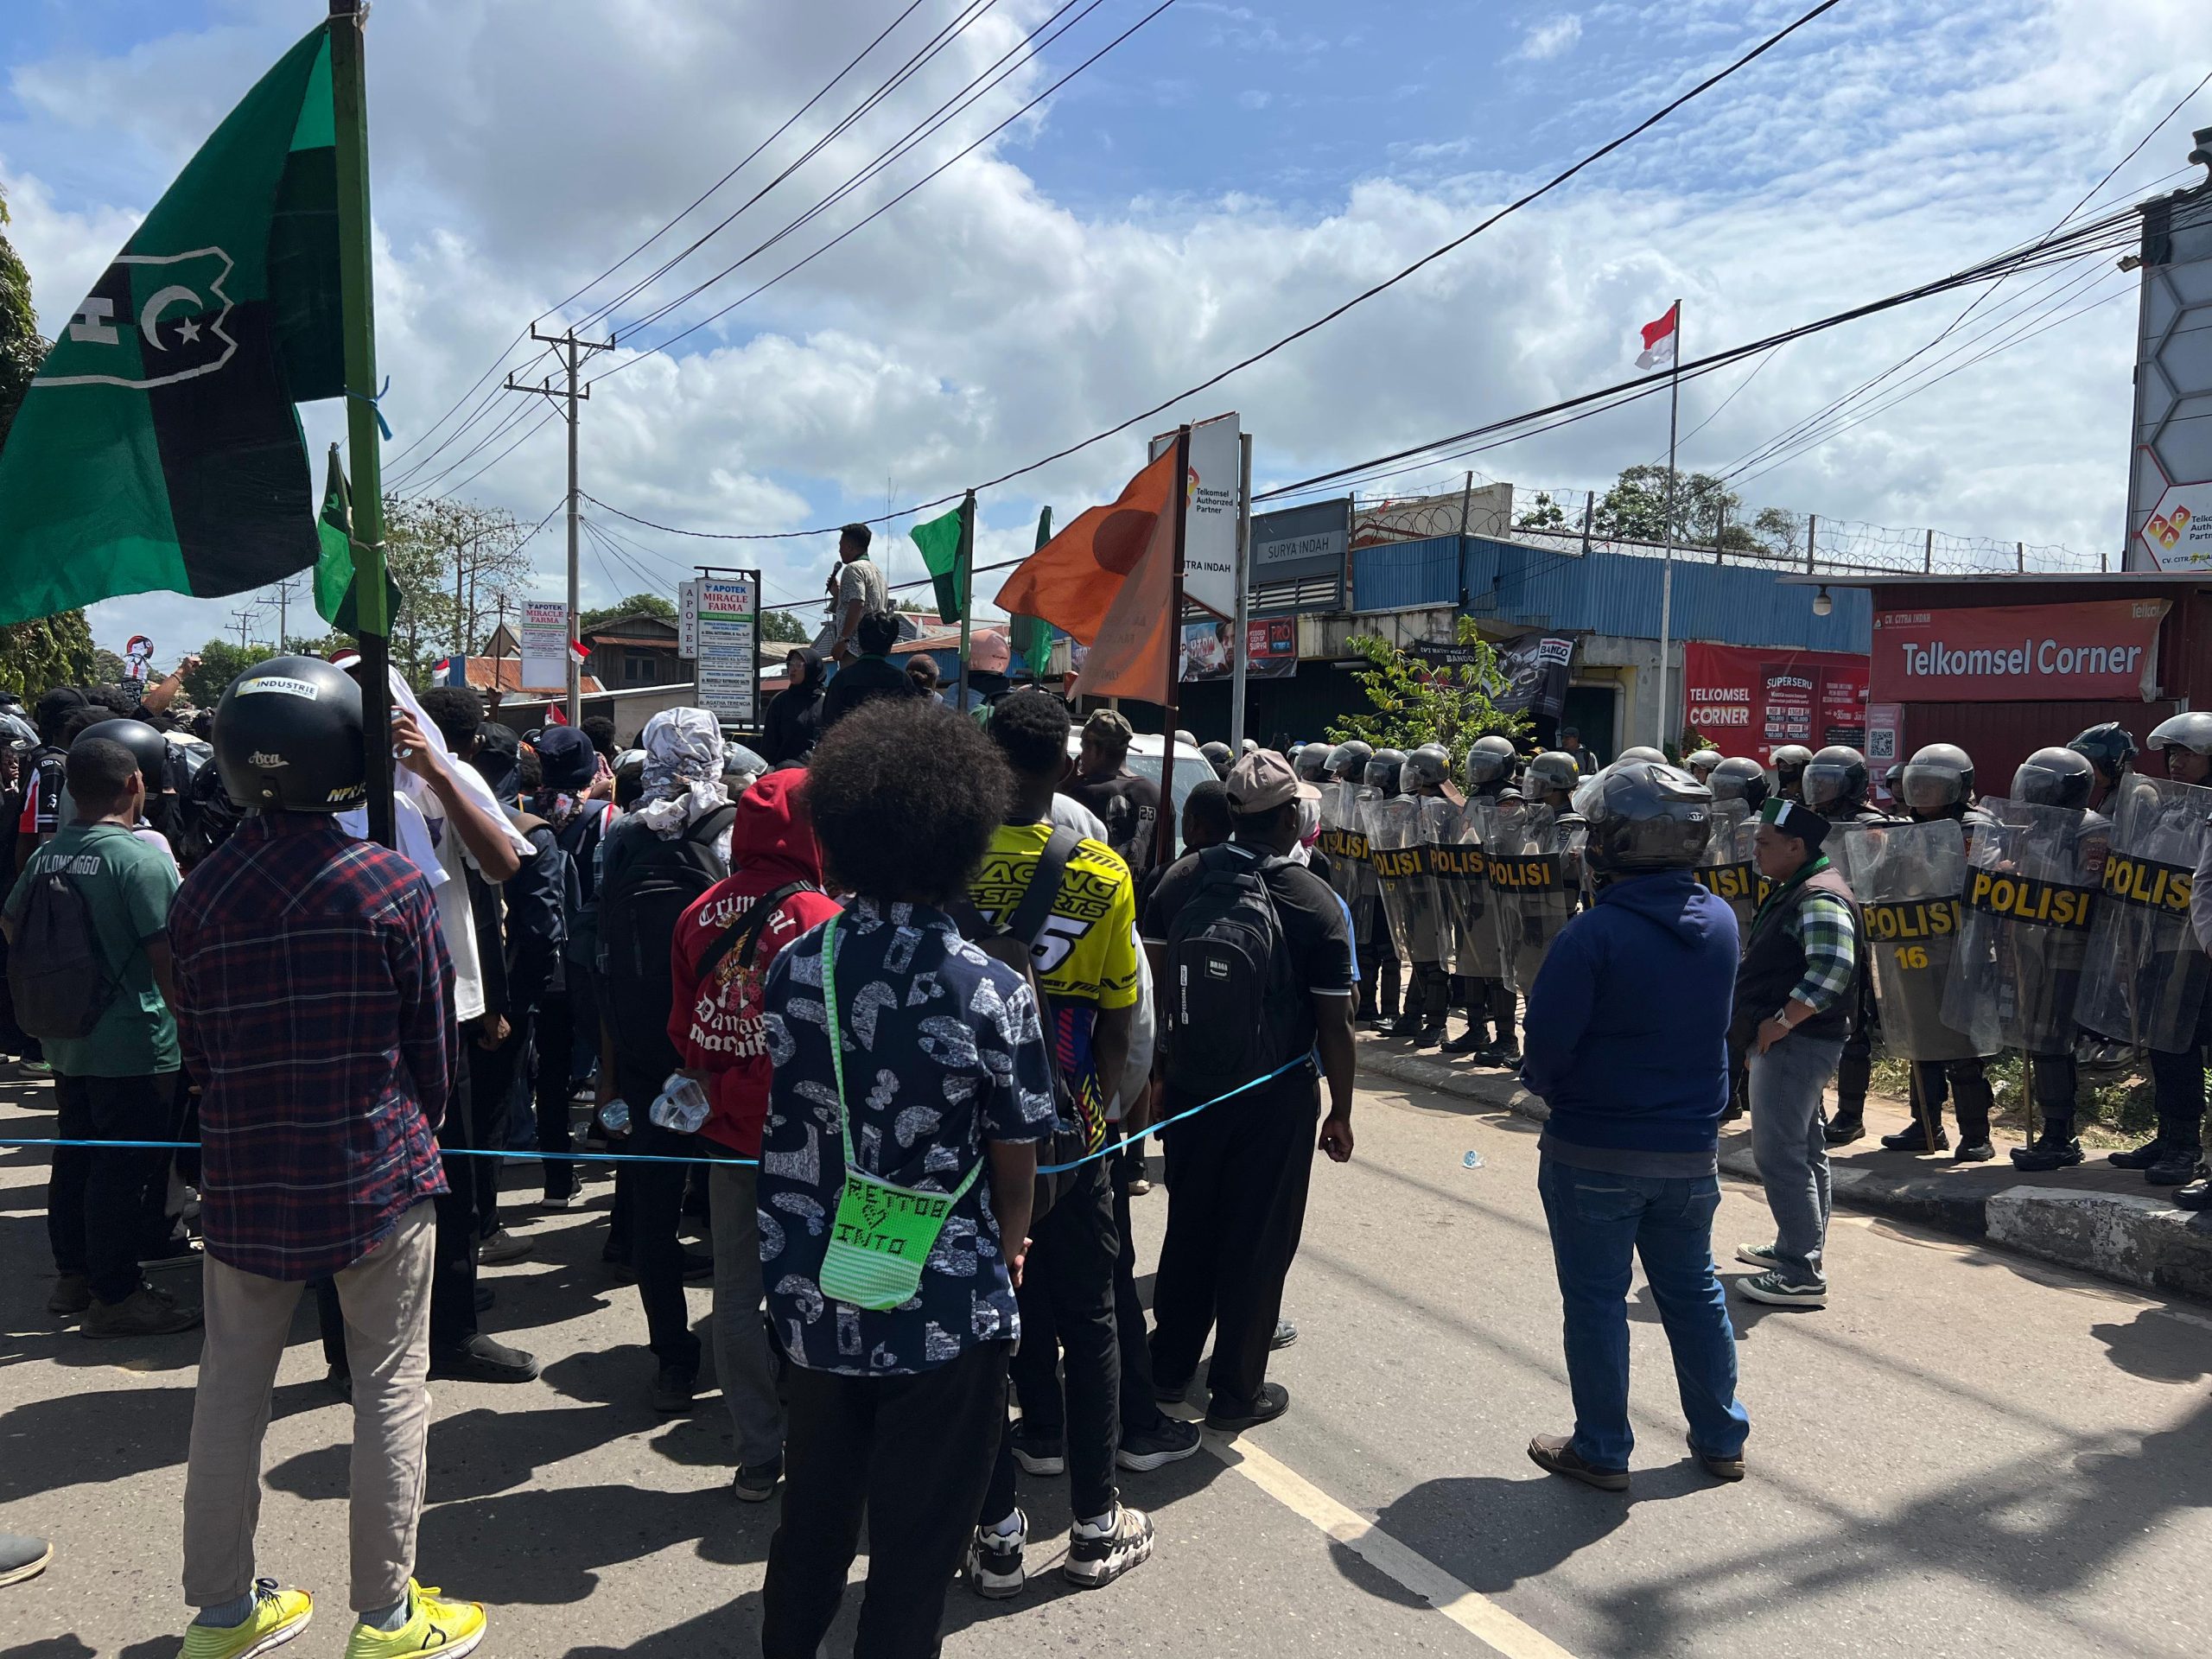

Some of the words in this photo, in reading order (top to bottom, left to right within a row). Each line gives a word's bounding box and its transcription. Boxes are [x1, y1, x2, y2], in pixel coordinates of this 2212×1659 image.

[1197, 487, 1230, 498] Telkomsel
[1197, 496, 1233, 507] Authorized
[1197, 505, 1222, 514] Partner
[1268, 543, 1296, 559] SURYA
[1299, 537, 1329, 554] INDAH
[1204, 563, 1231, 574] INDAH
[714, 585, 747, 594] APOTEK
[703, 593, 748, 604] MIRACLE
[709, 602, 743, 612] FARMA
[2132, 603, 2159, 619] Telko
[1540, 645, 1567, 658] BANDO
[1902, 639, 2031, 676] Telkomsel
[2037, 639, 2142, 674] Corner
[257, 680, 315, 695] INDUSTRIE
[1690, 689, 1750, 701] TELKOMSEL
[1690, 708, 1749, 725] CORNER
[1488, 861, 1550, 886] POLISI
[2102, 855, 2194, 908] POLIS
[1971, 873, 2089, 925] POLISI
[698, 893, 797, 935] Crimal
[1863, 899, 1961, 938] POLISI
[1894, 945, 1929, 969] 16
[836, 1223, 907, 1255] INTO
